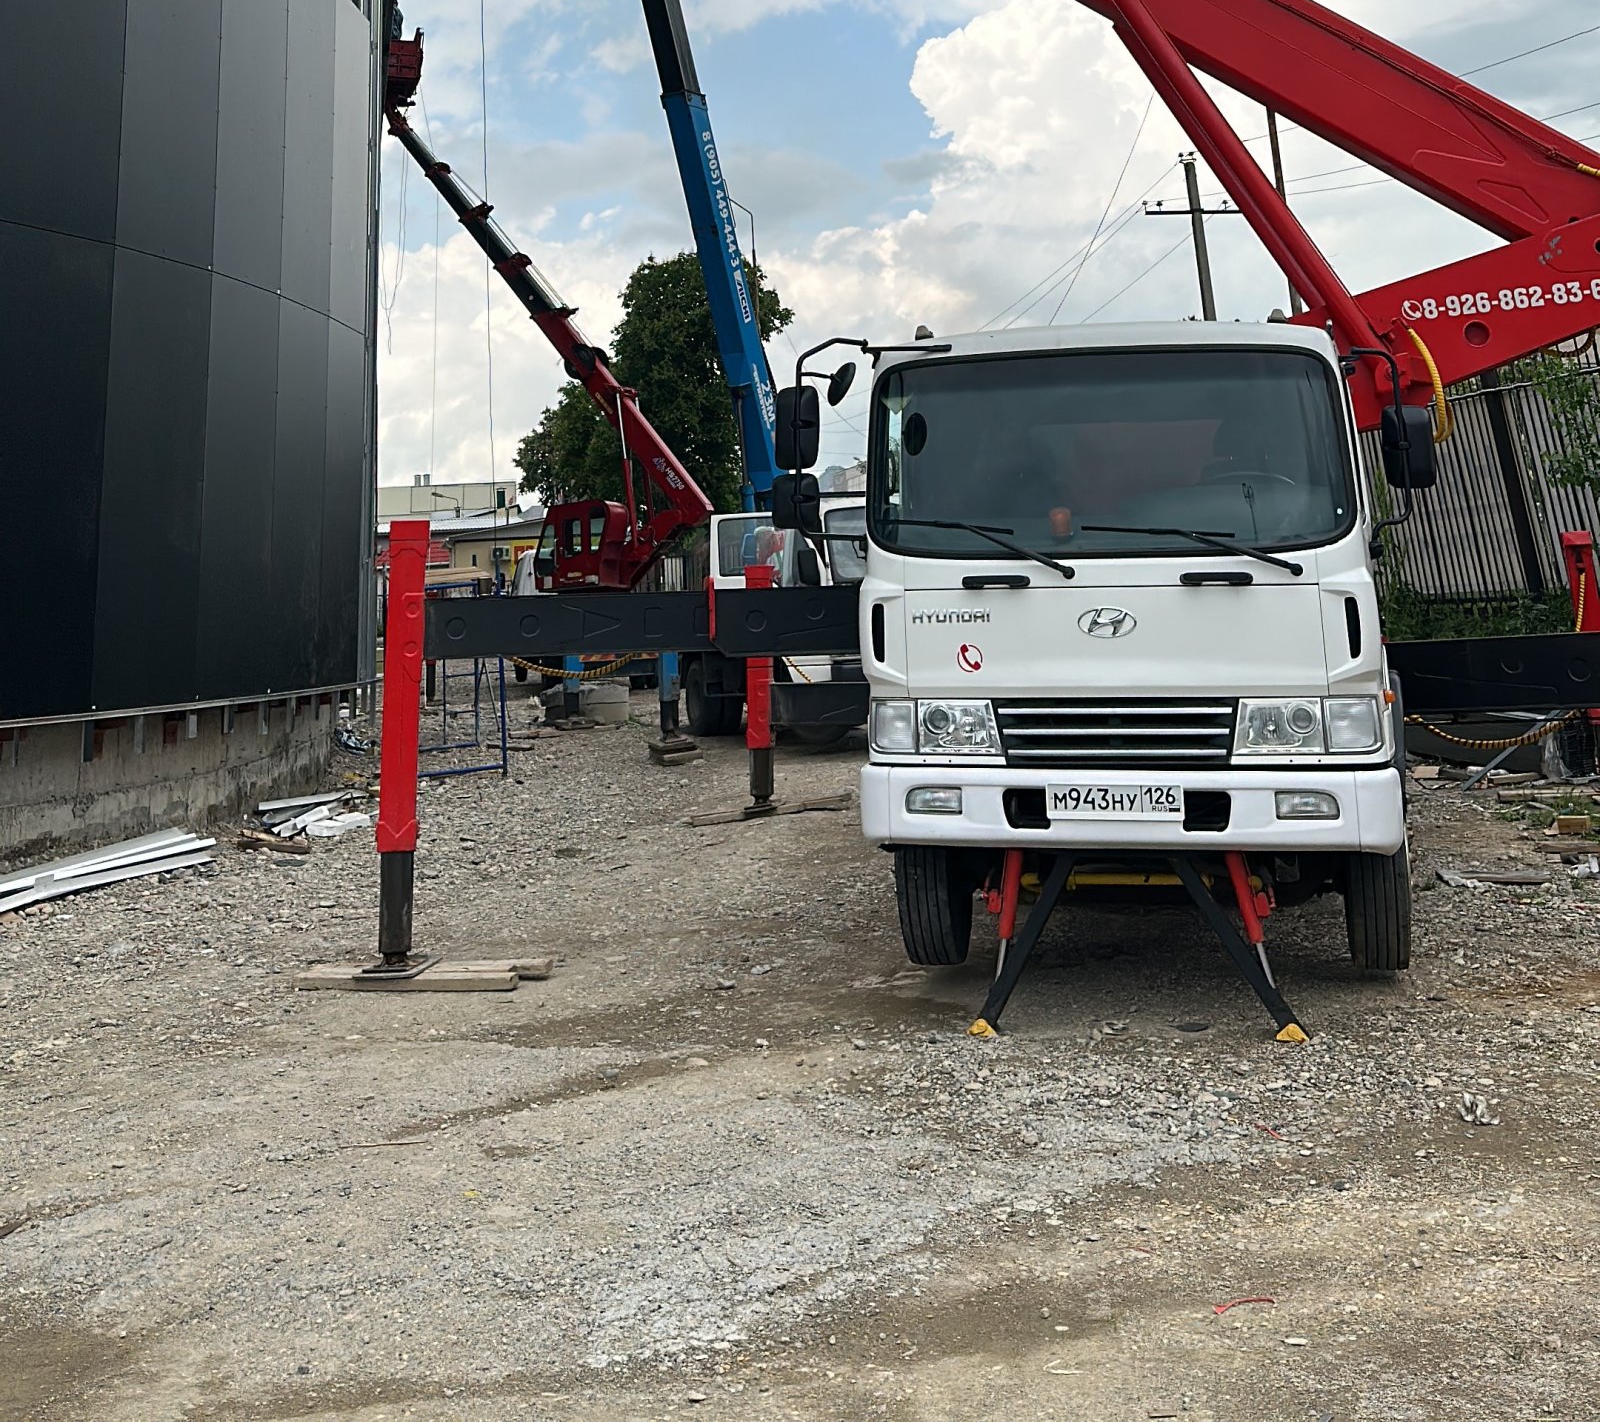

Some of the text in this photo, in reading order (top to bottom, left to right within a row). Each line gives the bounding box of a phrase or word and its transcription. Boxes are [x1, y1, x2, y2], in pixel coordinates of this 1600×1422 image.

[702, 130, 740, 268] 8 (905) 449-444-3
[736, 279, 750, 319] AICHI
[761, 380, 775, 423] 23M
[912, 609, 990, 624] HYUNDAI
[1144, 787, 1175, 805] 126
